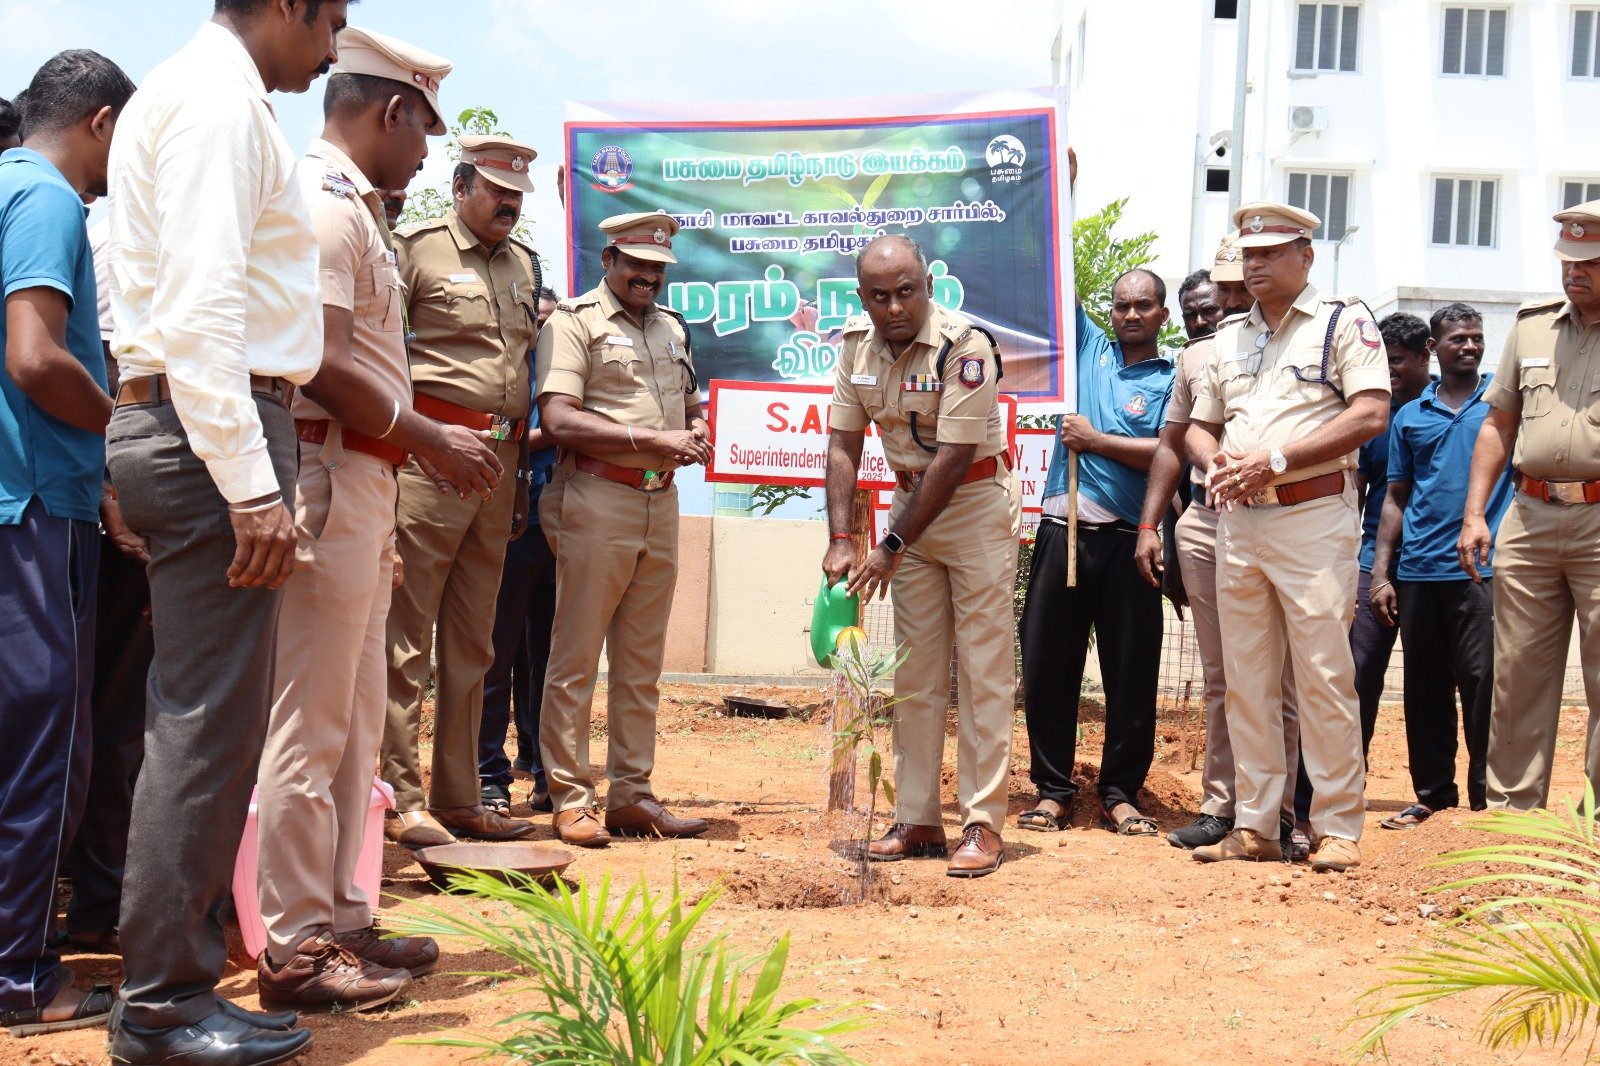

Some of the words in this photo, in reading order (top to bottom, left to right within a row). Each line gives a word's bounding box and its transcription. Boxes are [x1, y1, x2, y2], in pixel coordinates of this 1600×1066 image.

[663, 157, 743, 181] பசுமை
[743, 151, 857, 187] தமிழ்நாடு
[860, 146, 966, 174] இயக்கம்
[990, 168, 1023, 176] பசுமை
[991, 174, 1022, 183] தமிழகம்
[721, 211, 799, 228] மாவட்ட
[801, 206, 924, 229] காவல்துறை
[927, 201, 1006, 223] சார்பில்,
[730, 237, 800, 252] பசுமை
[801, 231, 885, 254] தமிழக
[668, 264, 801, 337] மரம்
[729, 443, 827, 470] Superintendent
[859, 450, 887, 476] lice,
[861, 472, 883, 481] 2025
